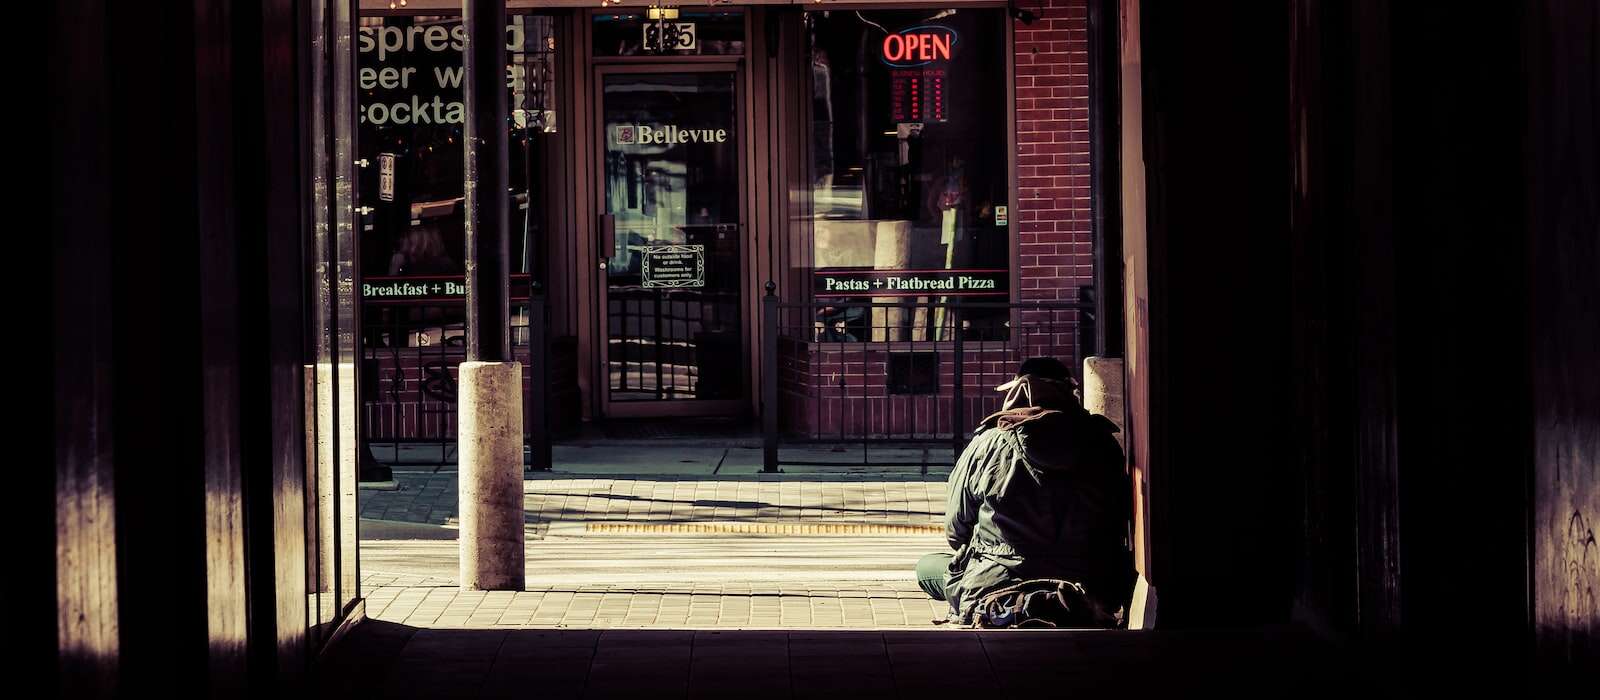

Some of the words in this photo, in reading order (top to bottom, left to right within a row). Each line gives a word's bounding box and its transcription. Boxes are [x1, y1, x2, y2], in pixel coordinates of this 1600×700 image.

[883, 33, 951, 61] OPEN
[637, 125, 727, 144] Bellevue
[363, 282, 428, 297] Breakfast
[445, 282, 466, 296] Bu
[825, 278, 869, 291] Pastas
[887, 276, 954, 290] Flatbread
[958, 276, 995, 289] Pizza
